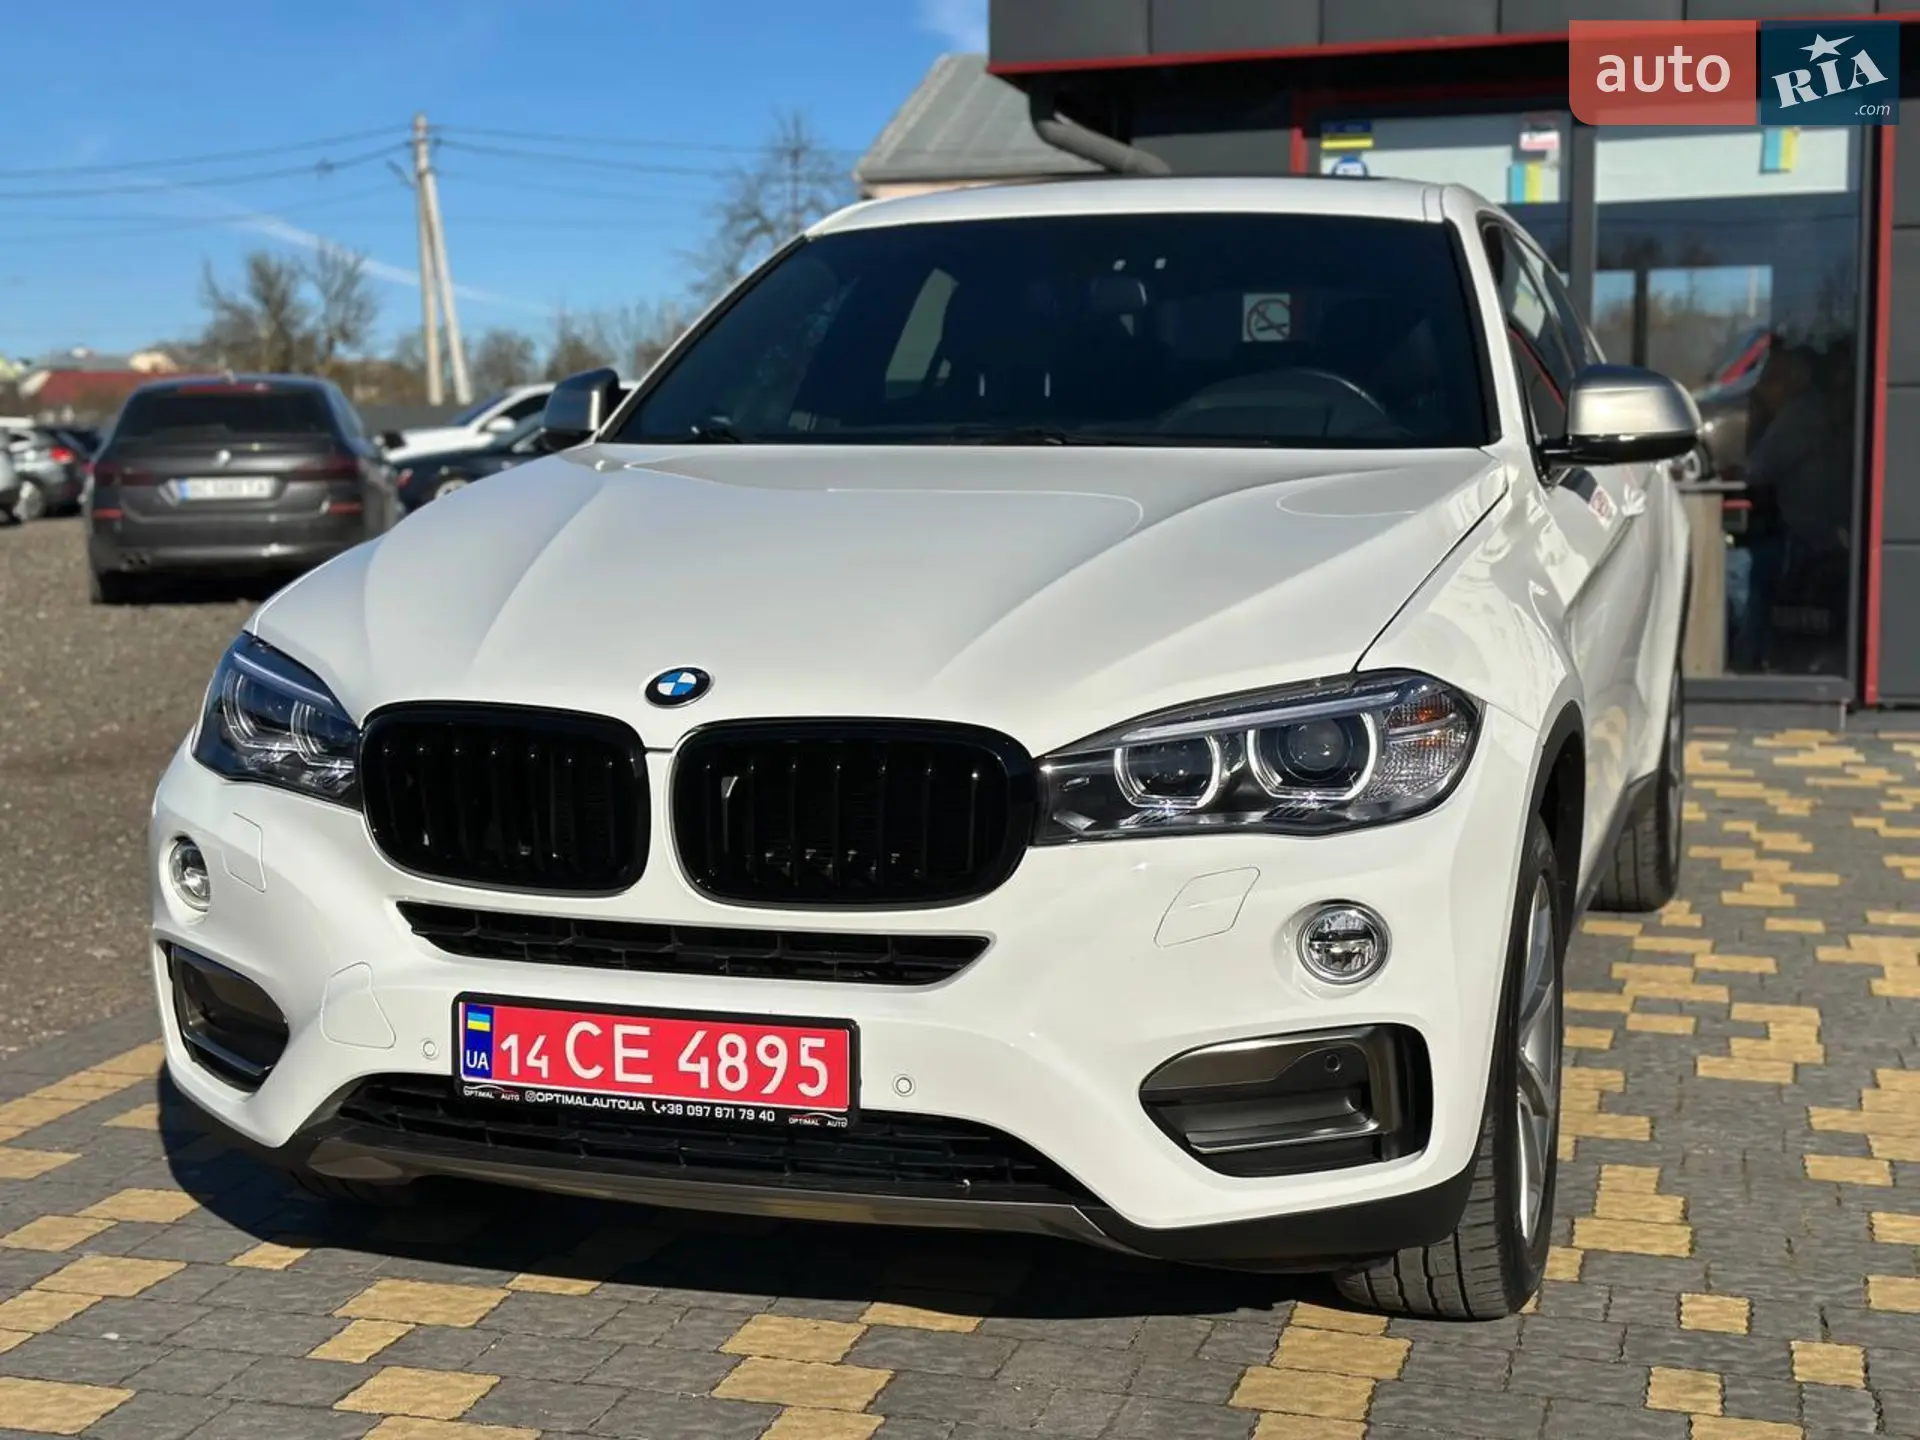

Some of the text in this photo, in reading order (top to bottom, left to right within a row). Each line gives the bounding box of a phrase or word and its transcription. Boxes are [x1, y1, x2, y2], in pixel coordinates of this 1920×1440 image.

[466, 1050, 489, 1070] UA
[501, 1021, 829, 1097] 14 CE 4895
[463, 1088, 520, 1101] OPTIMAL AUTO
[660, 1103, 683, 1115] +38
[686, 1104, 711, 1117] 097
[715, 1107, 735, 1119] 871
[739, 1108, 755, 1120] 79
[758, 1110, 775, 1122] 40
[788, 1117, 847, 1128] OPTIMAL AUTO
